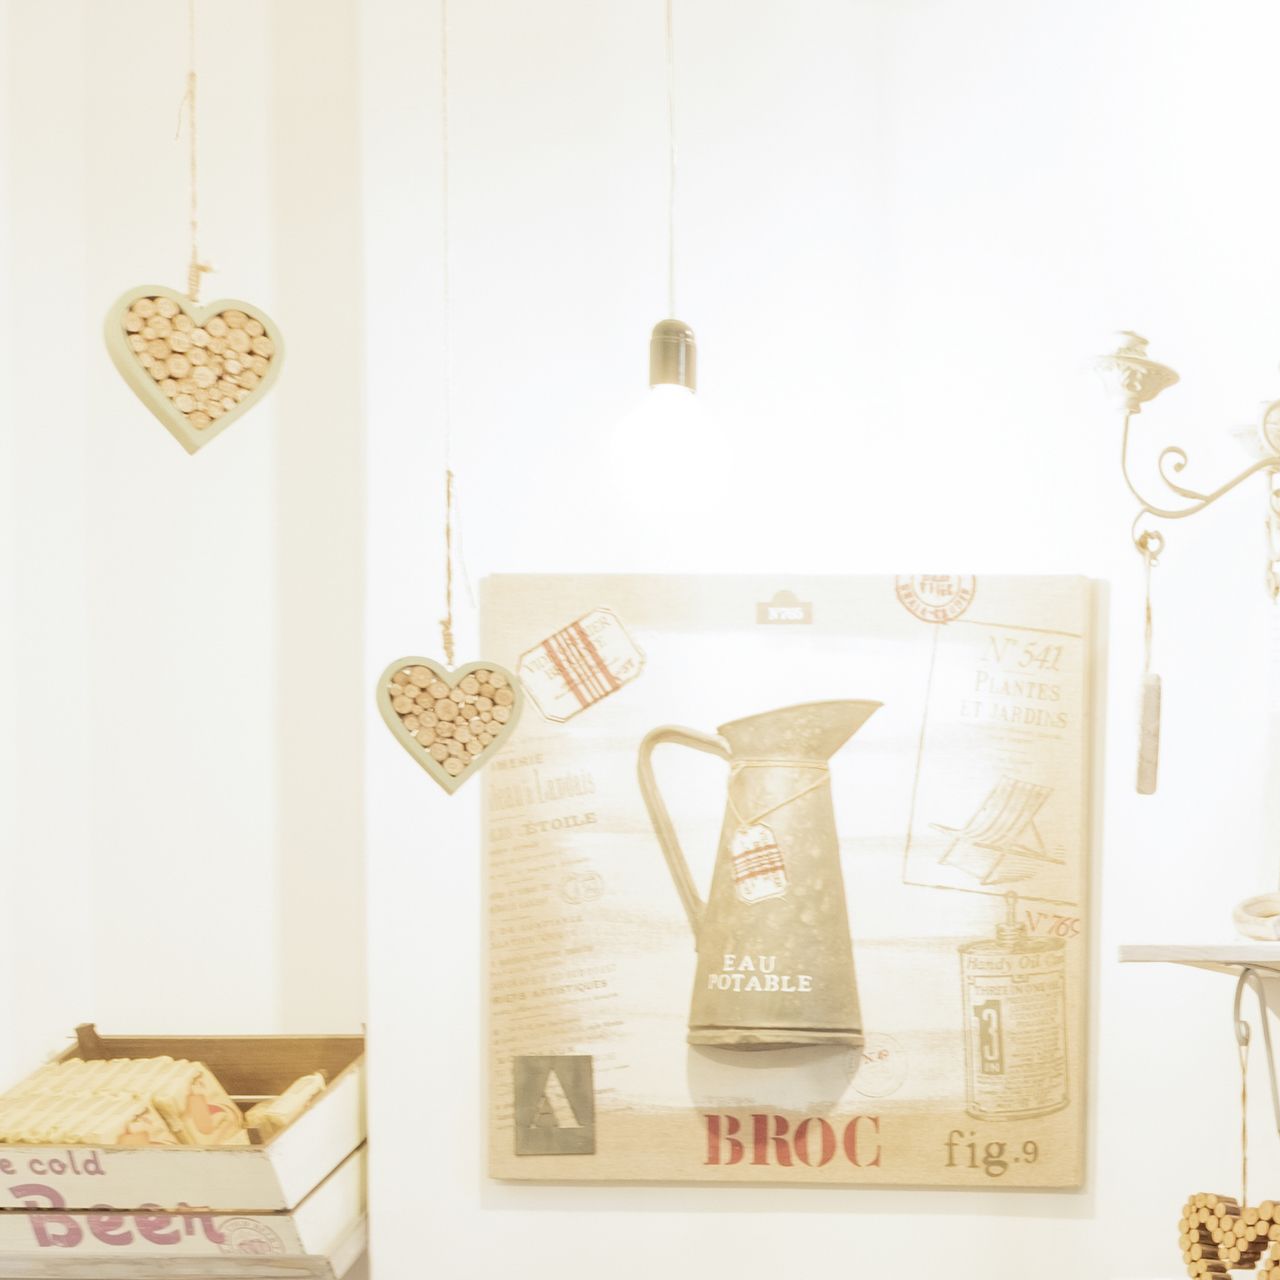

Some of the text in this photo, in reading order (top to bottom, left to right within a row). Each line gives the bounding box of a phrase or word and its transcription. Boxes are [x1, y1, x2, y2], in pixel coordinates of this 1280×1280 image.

[1017, 641, 1065, 672] 541
[975, 669, 1061, 702] PLANTES
[960, 699, 1069, 729] ET JARDINS
[723, 954, 776, 973] EAU
[707, 974, 813, 993] POTABLE
[982, 1007, 999, 1061] 3
[703, 1113, 881, 1168] BROC
[29, 1149, 106, 1175] cold
